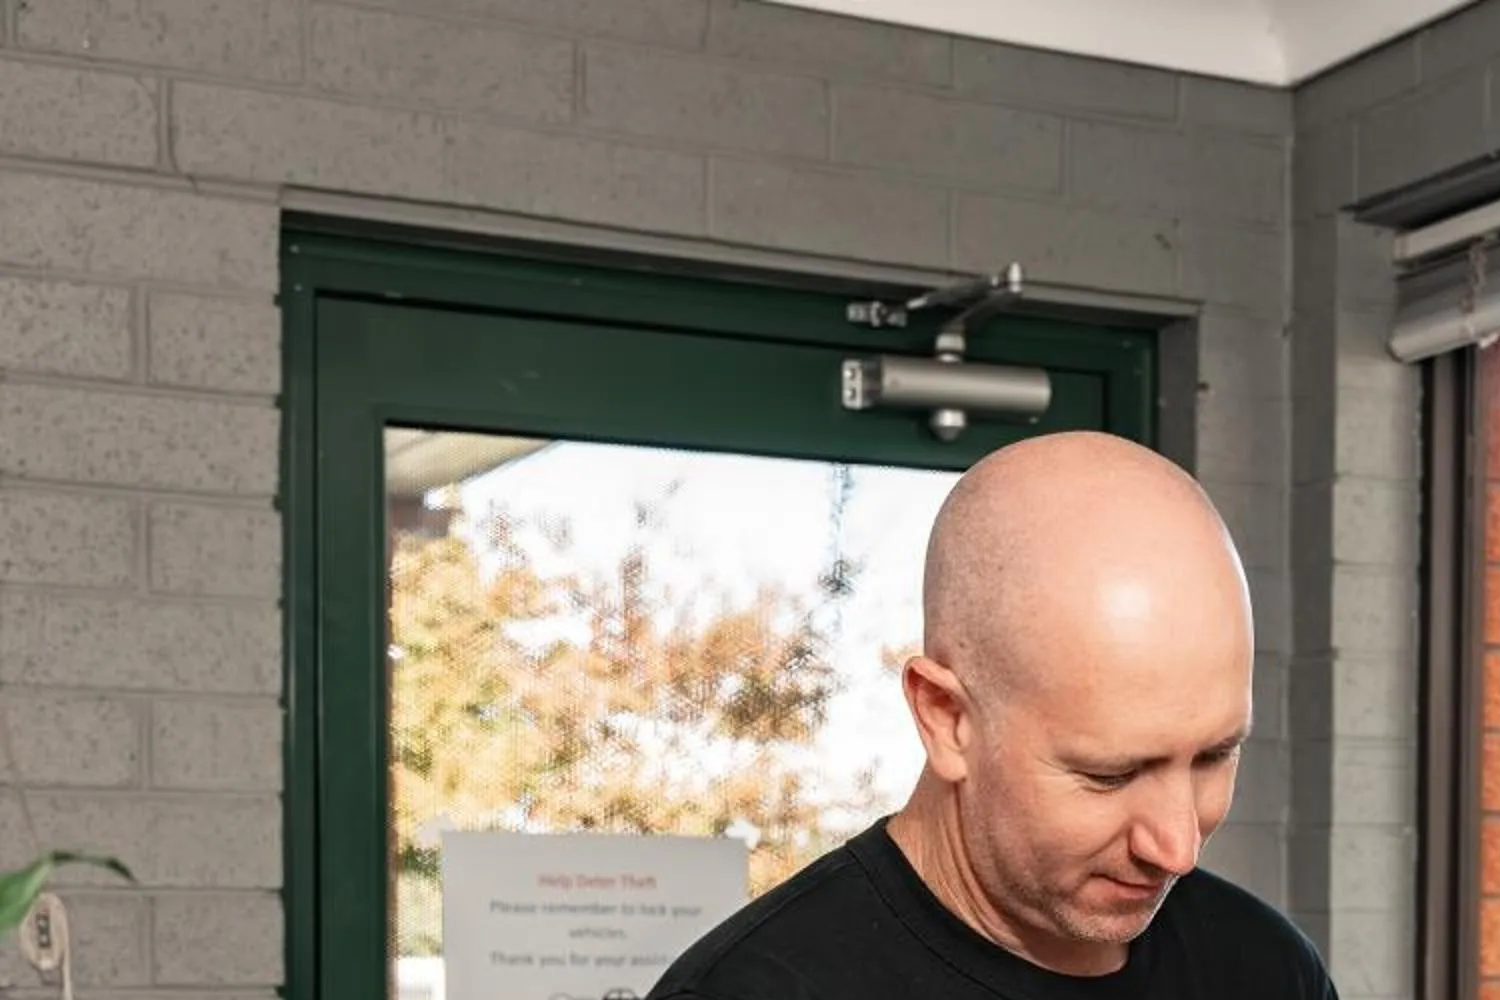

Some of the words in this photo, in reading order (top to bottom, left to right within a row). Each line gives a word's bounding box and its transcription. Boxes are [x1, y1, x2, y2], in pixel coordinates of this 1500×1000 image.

[489, 900, 536, 914] Please
[541, 901, 619, 916] remember
[621, 903, 635, 916] to
[671, 905, 702, 921] your
[489, 952, 534, 966] Thank
[539, 954, 566, 969] you
[569, 952, 590, 966] for
[594, 954, 627, 969] your
